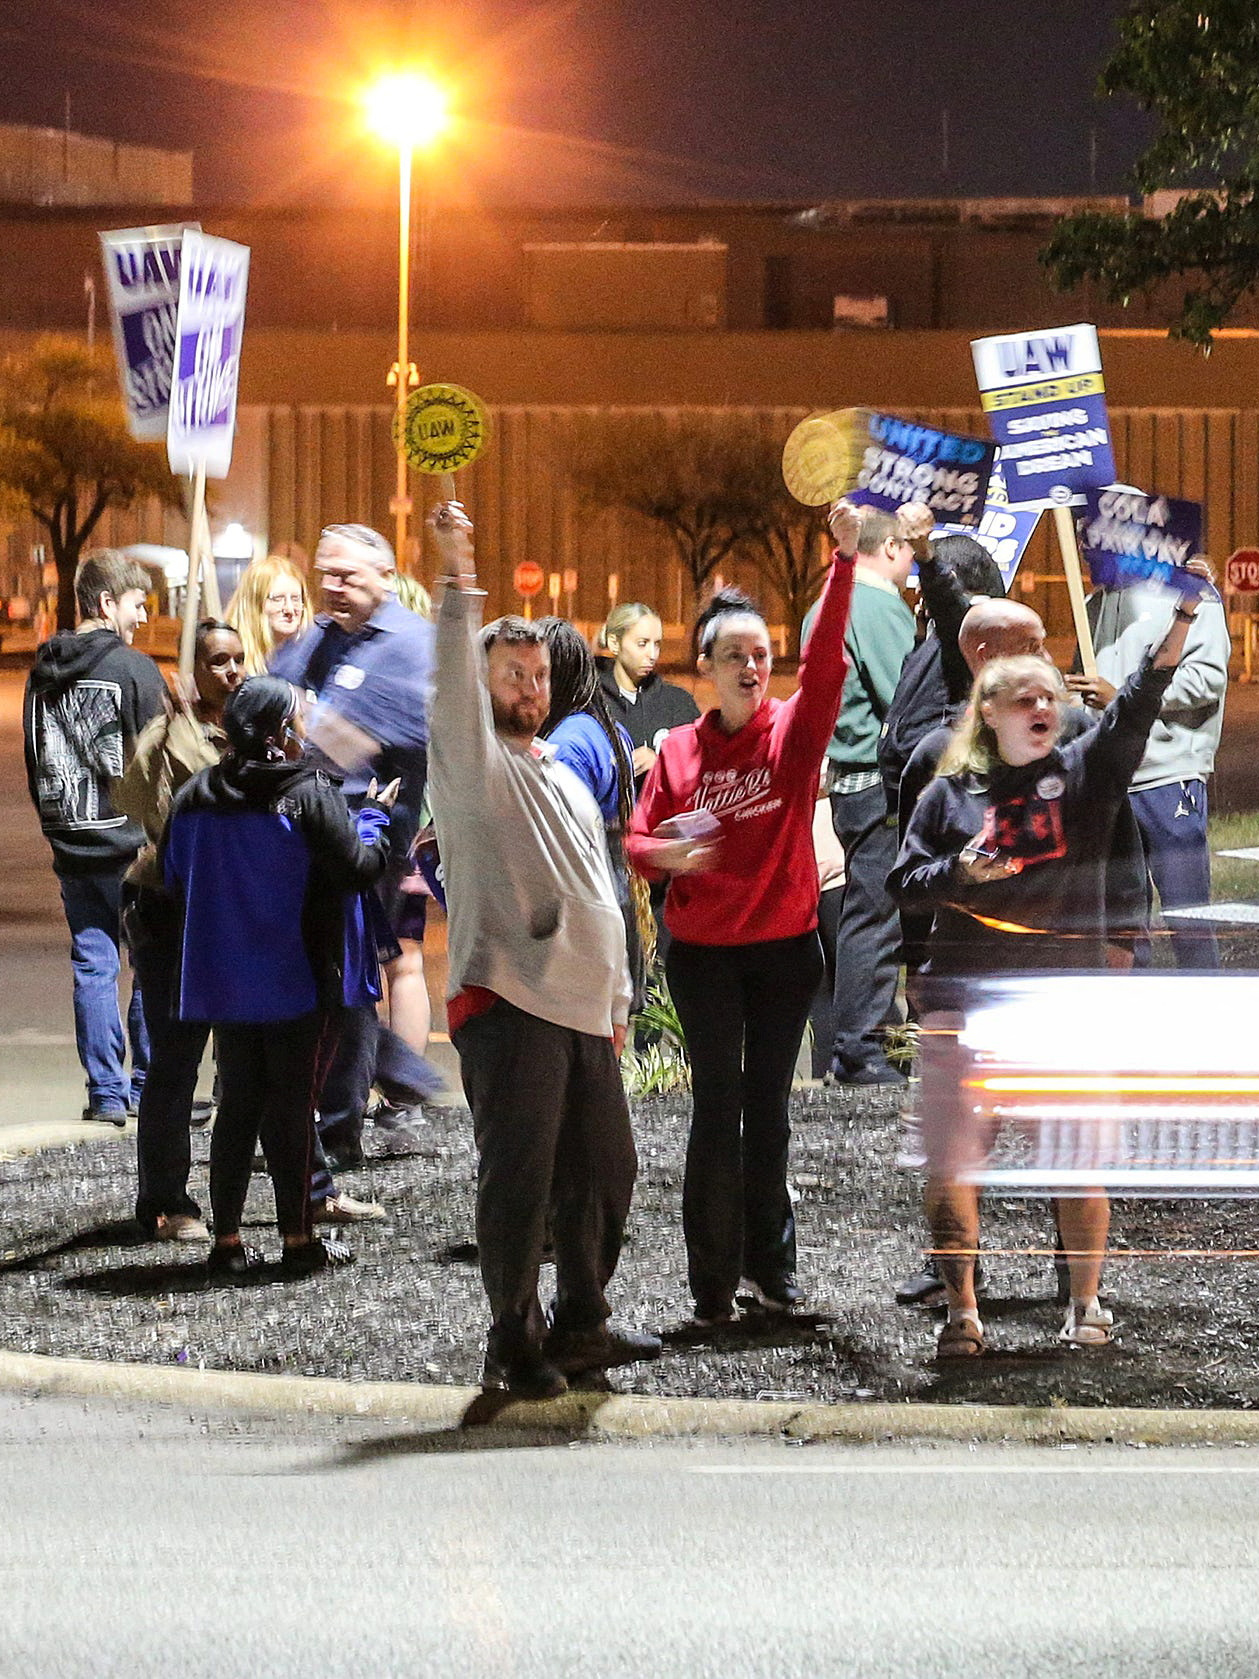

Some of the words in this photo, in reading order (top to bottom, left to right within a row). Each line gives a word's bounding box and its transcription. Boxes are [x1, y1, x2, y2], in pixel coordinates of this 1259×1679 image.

[999, 335, 1073, 378] UAW
[863, 446, 980, 496] STRONG
[1098, 491, 1170, 527] COLA
